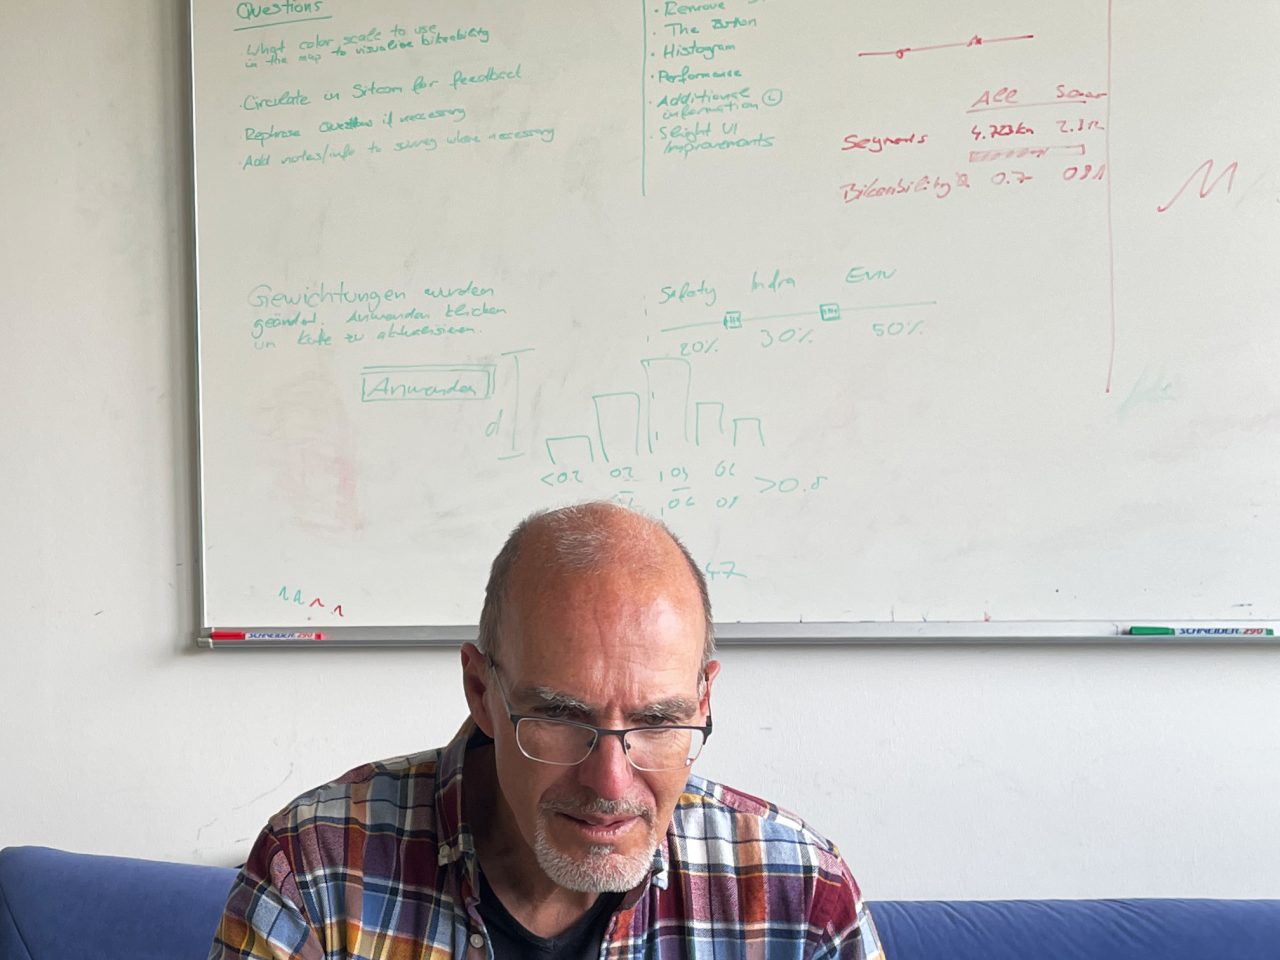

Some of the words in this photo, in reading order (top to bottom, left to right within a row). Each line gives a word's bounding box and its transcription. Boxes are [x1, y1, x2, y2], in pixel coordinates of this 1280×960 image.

[236, 0, 323, 20] Questions
[246, 39, 286, 57] What
[298, 33, 335, 51] color
[342, 27, 382, 46] scale
[389, 23, 407, 37] to
[413, 23, 438, 35] use
[664, 22, 700, 37] The
[264, 52, 288, 65] the
[330, 47, 347, 57] to
[662, 39, 736, 61] Histogram
[657, 64, 743, 85] Performance
[243, 88, 312, 111] Circulate
[323, 91, 340, 101] in
[411, 75, 440, 95] for
[449, 63, 522, 91] feedback
[382, 110, 393, 129] if
[659, 121, 712, 143] Slight
[242, 154, 271, 171] Add
[247, 280, 407, 313] Gewichtungen
[679, 336, 720, 357] 20%
[759, 327, 814, 349] 30%
[871, 319, 925, 337] 50%
